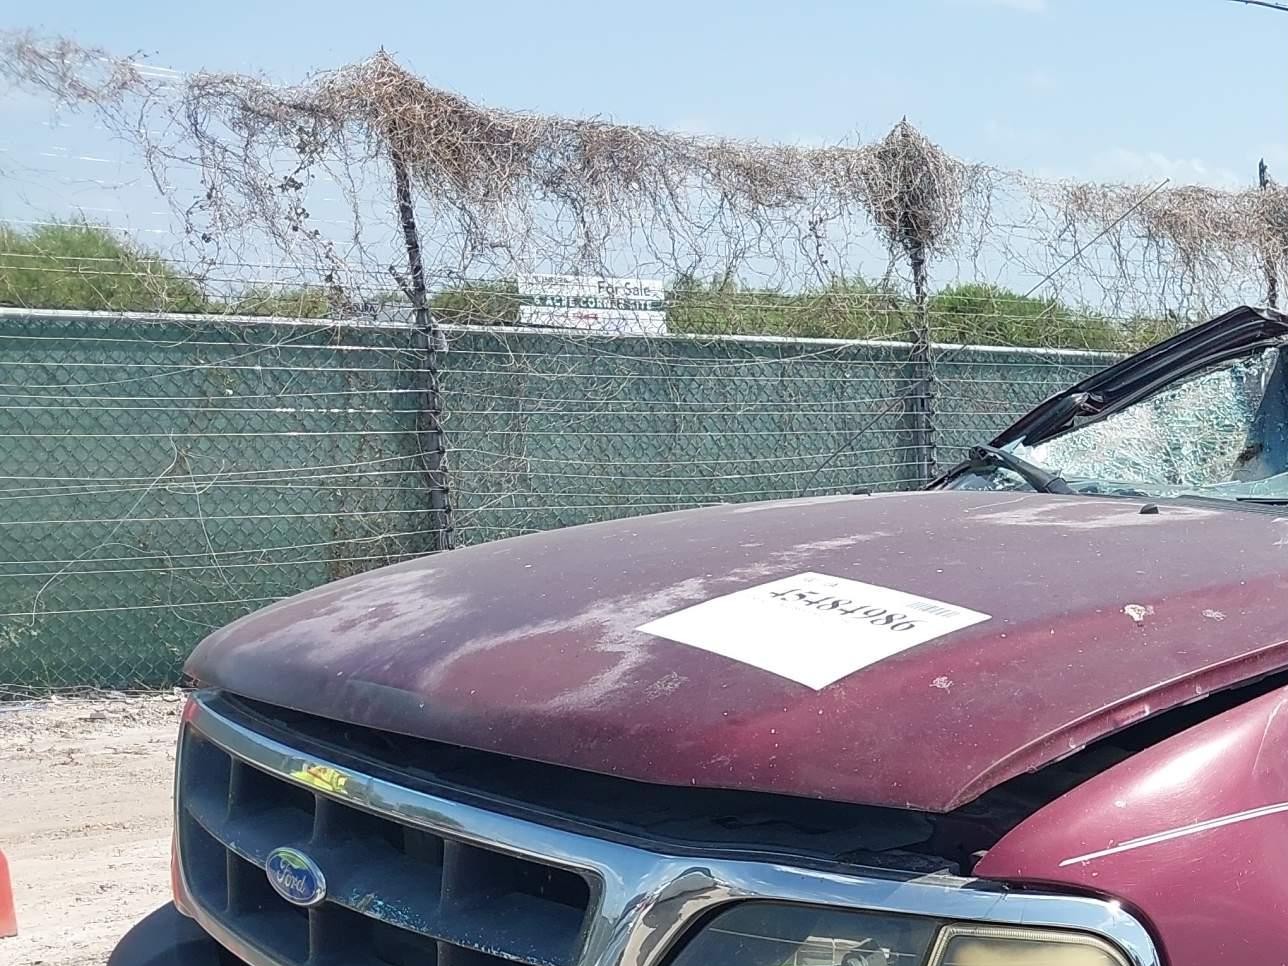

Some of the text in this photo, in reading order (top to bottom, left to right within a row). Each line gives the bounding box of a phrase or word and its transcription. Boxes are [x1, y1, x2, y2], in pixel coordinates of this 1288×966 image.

[597, 280, 651, 297] For Sale
[769, 587, 926, 632] 45484986
[276, 859, 307, 895] Ford
